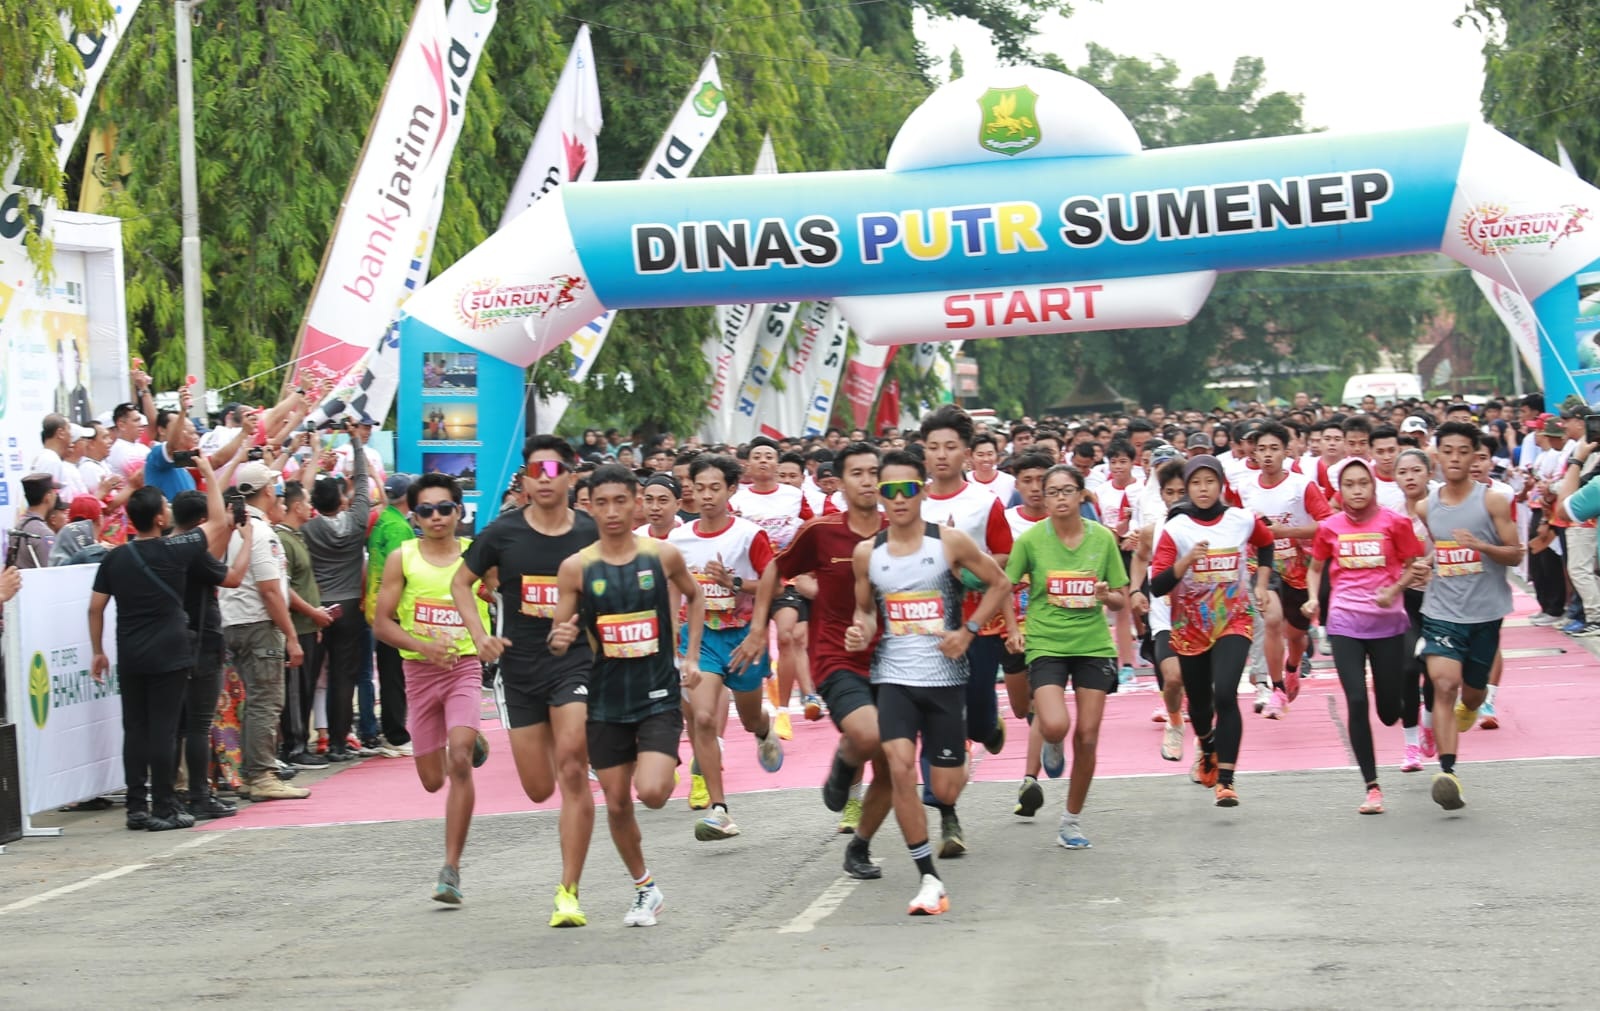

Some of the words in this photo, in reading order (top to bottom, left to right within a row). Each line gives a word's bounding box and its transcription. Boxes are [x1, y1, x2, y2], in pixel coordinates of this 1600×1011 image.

[342, 103, 436, 303] bankjatim
[632, 218, 839, 275] DINAS
[858, 200, 1047, 264] PUTR
[1059, 168, 1393, 249] SUMENEP
[944, 284, 1104, 329] START
[902, 601, 940, 619] 1202
[1065, 580, 1094, 595] 1176
